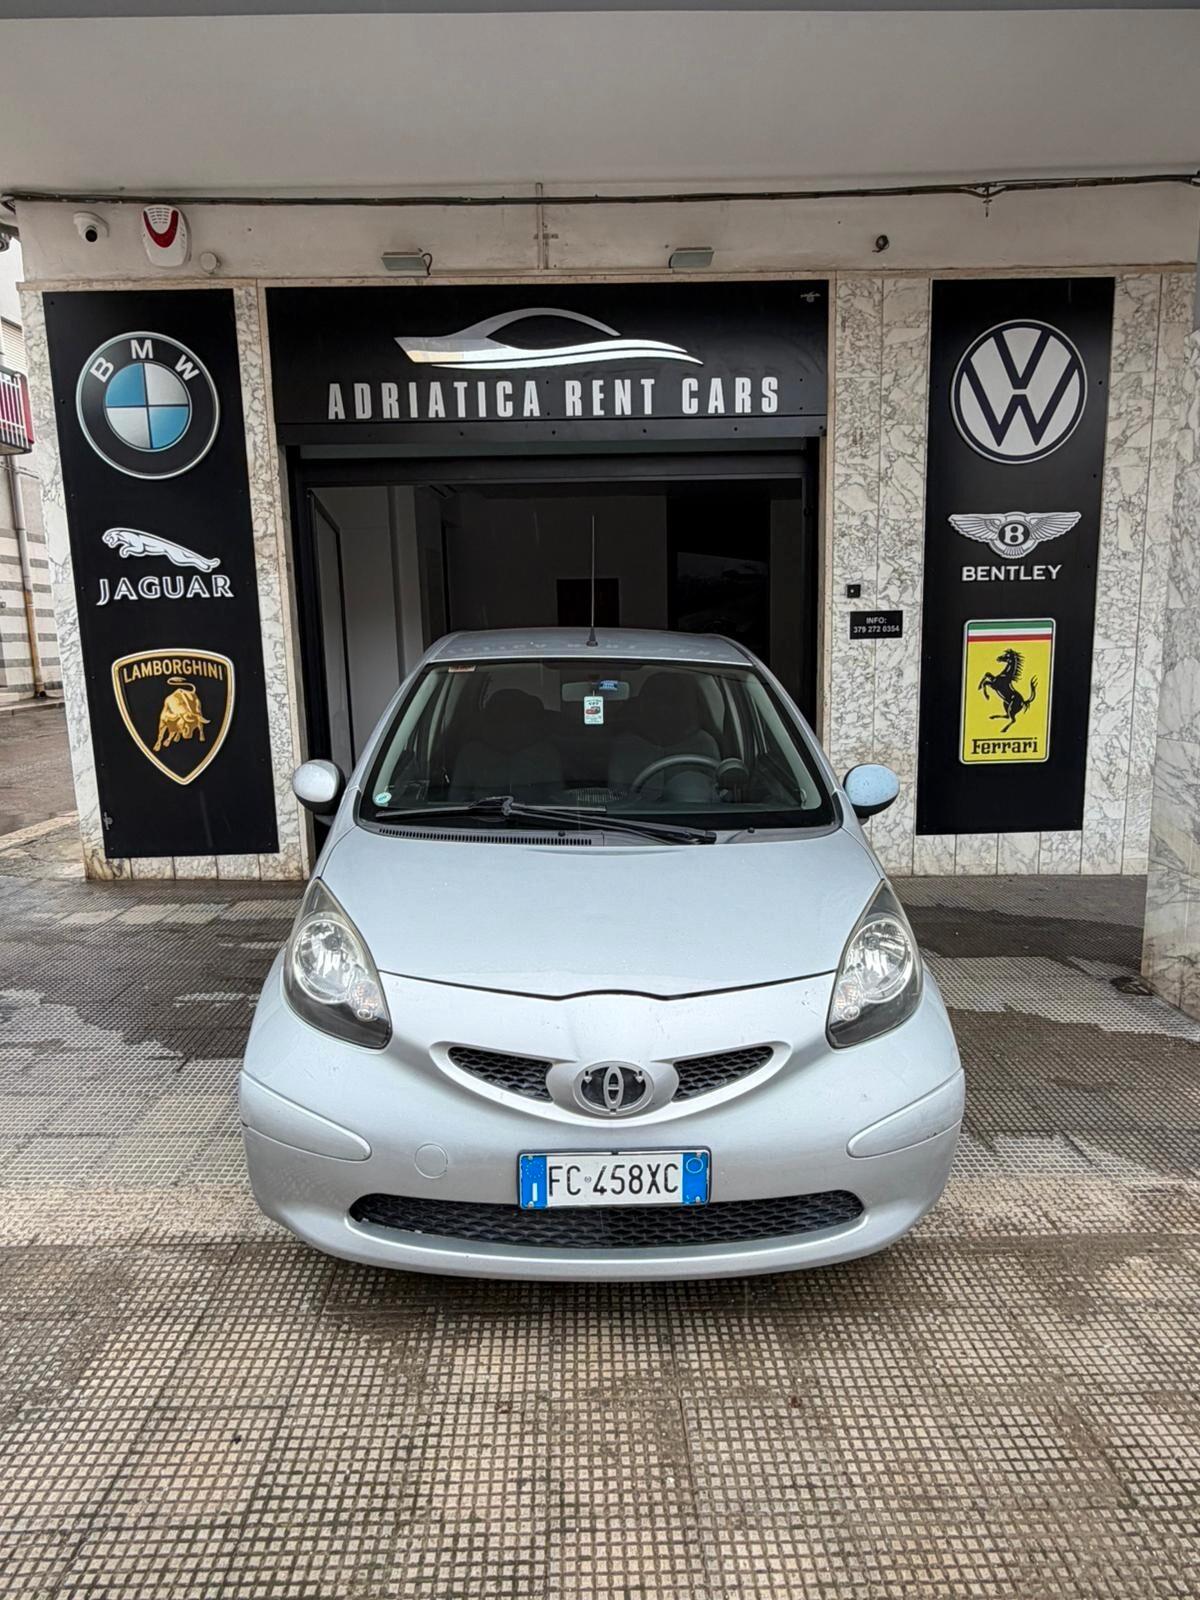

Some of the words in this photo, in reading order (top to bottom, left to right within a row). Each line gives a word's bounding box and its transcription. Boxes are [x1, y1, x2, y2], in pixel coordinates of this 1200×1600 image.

[89, 339, 201, 383] BMW
[327, 380, 541, 420] ADRIATICA
[565, 379, 655, 417] RENT
[681, 376, 779, 415] CARS
[961, 564, 1063, 582] BENTLEY
[96, 574, 235, 606] JAGUAR
[865, 616, 887, 624] INFO:
[867, 625, 881, 633] 272
[123, 659, 224, 684] LAMBORGHINI
[971, 737, 1039, 755] Ferrari
[548, 1164, 581, 1197] FC
[592, 1162, 679, 1196] 458XC
